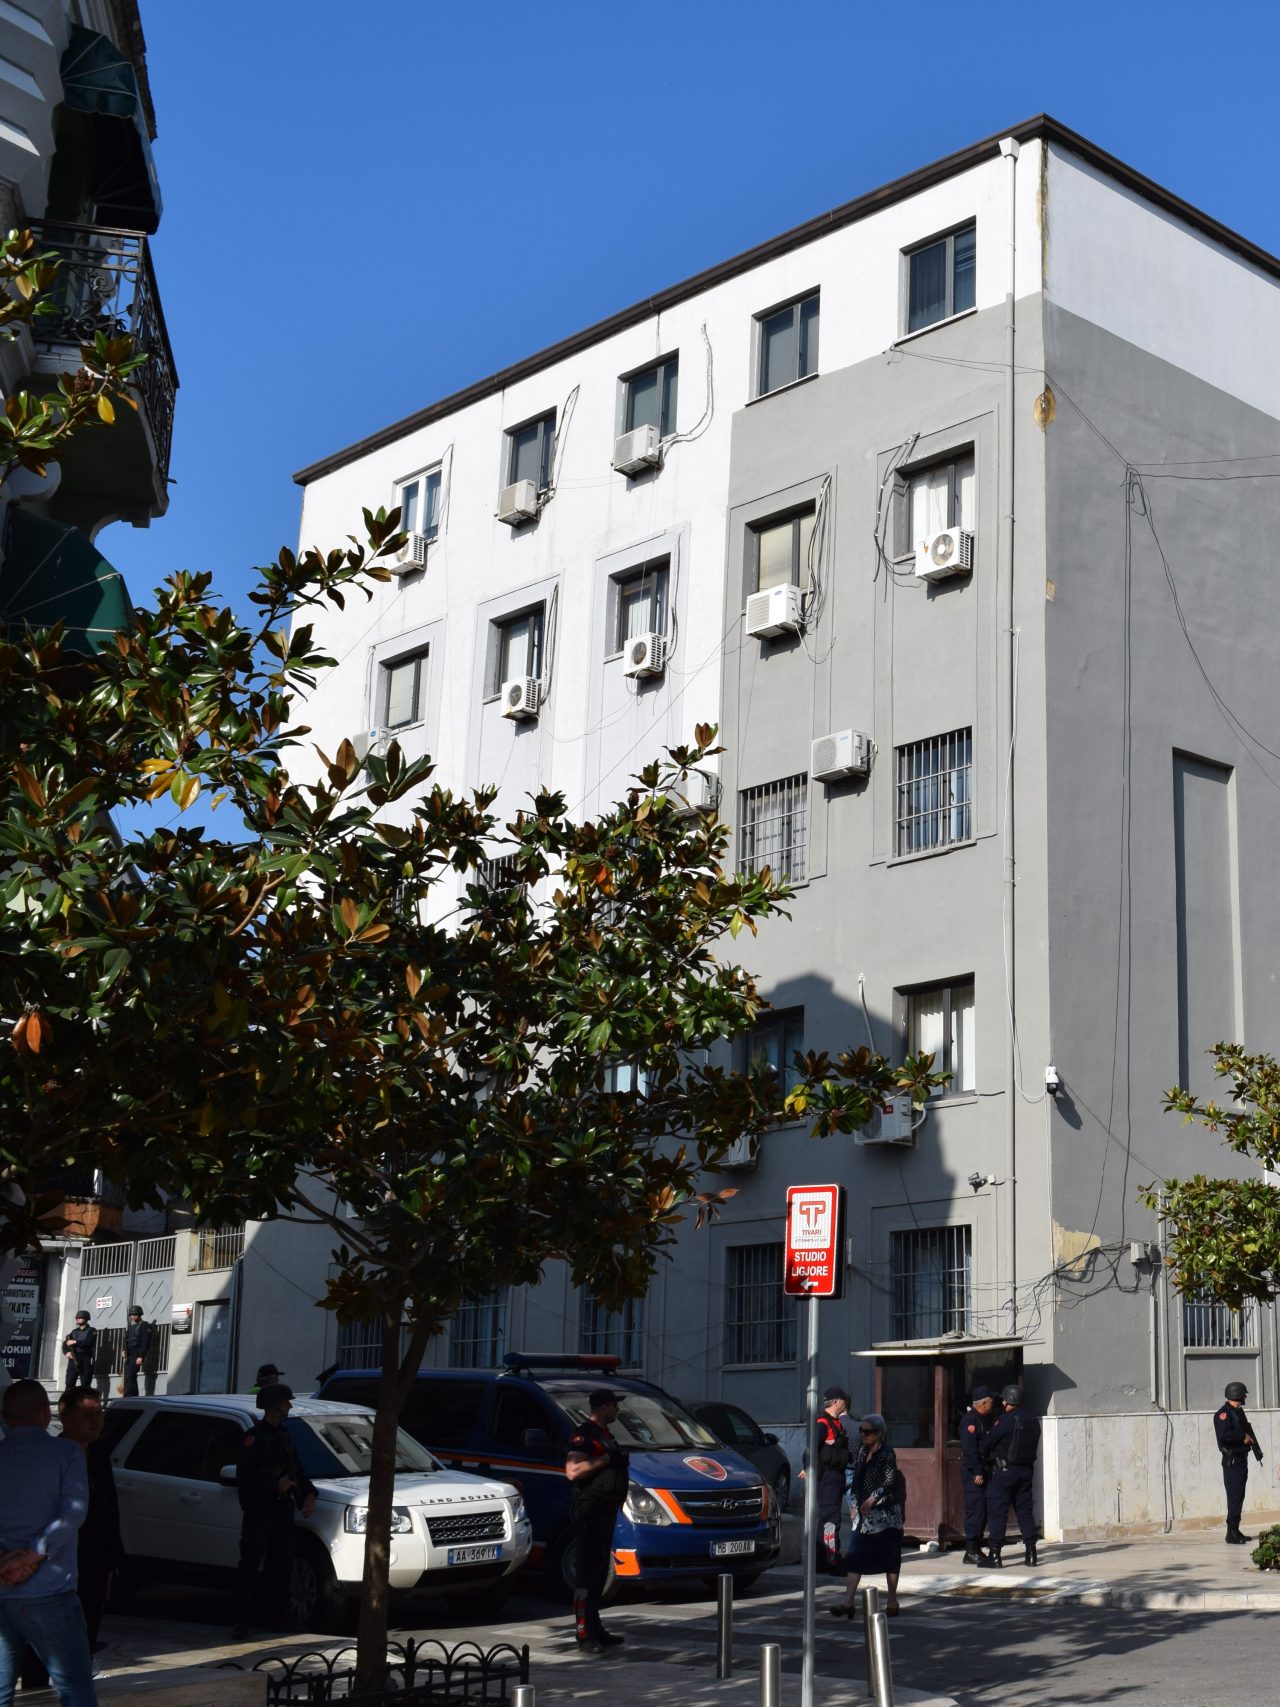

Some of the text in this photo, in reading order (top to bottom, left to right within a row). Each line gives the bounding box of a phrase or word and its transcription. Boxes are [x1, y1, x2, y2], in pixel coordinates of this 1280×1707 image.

[794, 1251, 827, 1262] STUDIO
[792, 1266, 828, 1277] LIGJORE
[8, 1302, 31, 1314] KATE
[420, 1493, 497, 1505] LAND ROVER
[717, 1543, 727, 1554] MB
[456, 1551, 466, 1562] AA
